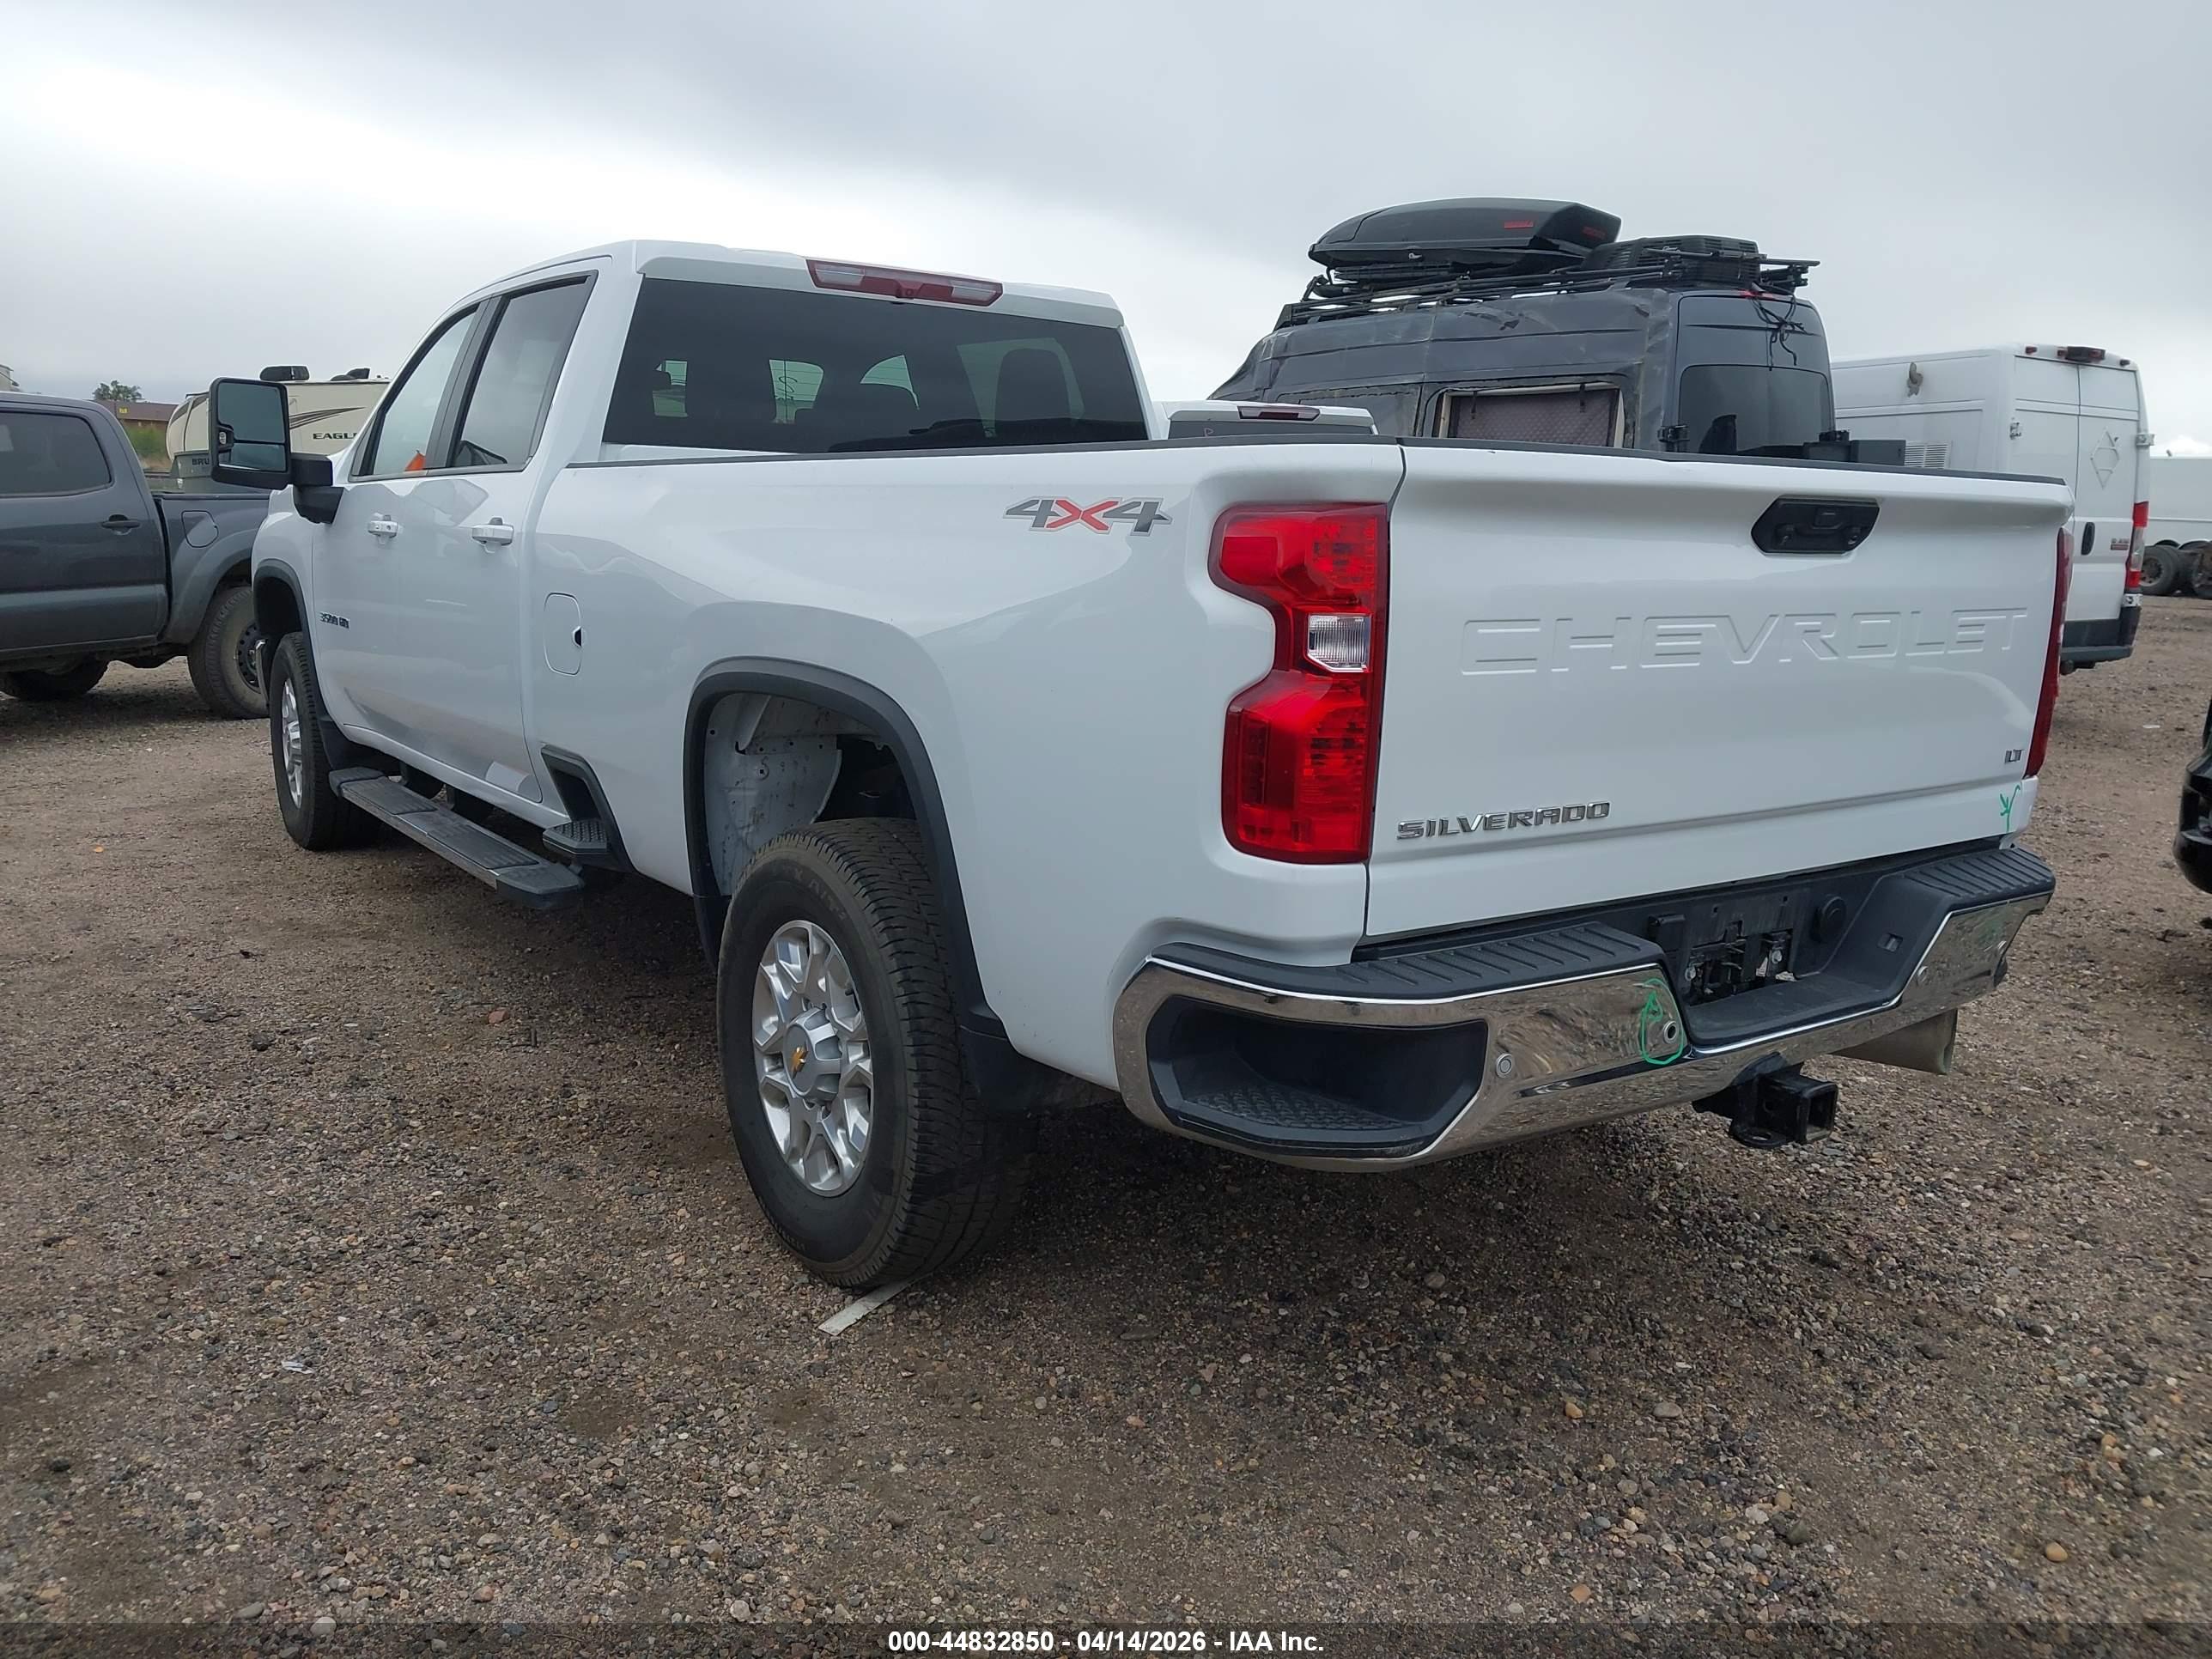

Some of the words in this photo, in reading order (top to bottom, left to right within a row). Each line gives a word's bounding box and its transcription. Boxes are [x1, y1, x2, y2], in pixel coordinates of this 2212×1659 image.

[1462, 607, 2027, 675] CHEVROLET
[2004, 749, 2025, 763] LT
[1396, 801, 1611, 841] SILVERADO
